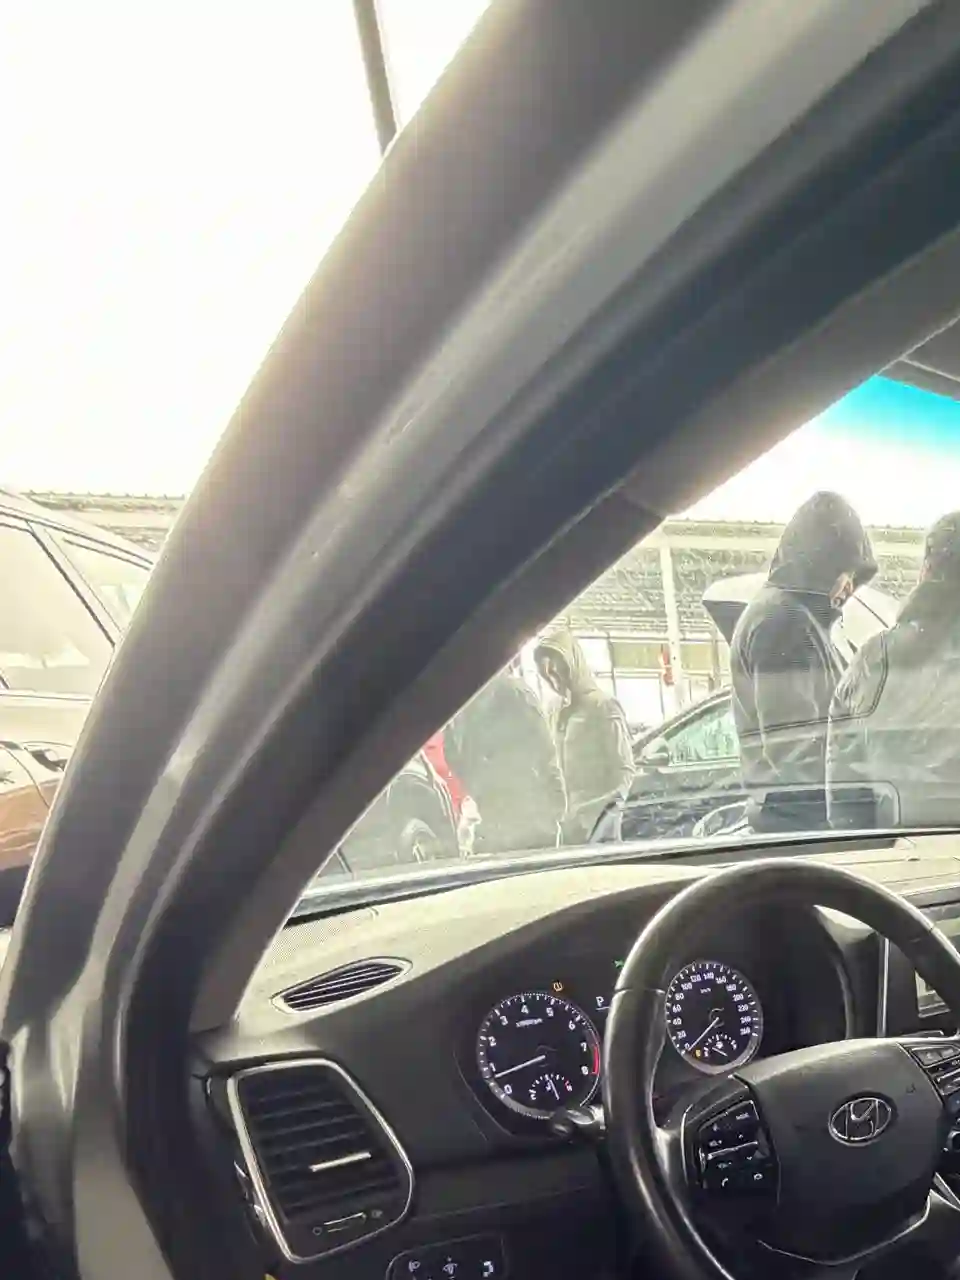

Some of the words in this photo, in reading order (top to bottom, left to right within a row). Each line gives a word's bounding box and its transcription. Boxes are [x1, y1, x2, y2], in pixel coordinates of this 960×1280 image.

[521, 1004, 529, 1014] 4
[546, 1007, 554, 1017] 5
[500, 1015, 508, 1026] 3
[568, 1020, 576, 1030] 6
[488, 1036, 497, 1047] 2
[580, 1042, 587, 1052] 7
[489, 1062, 496, 1072] 1
[580, 1065, 589, 1075] 8
[504, 1084, 512, 1094] 0
